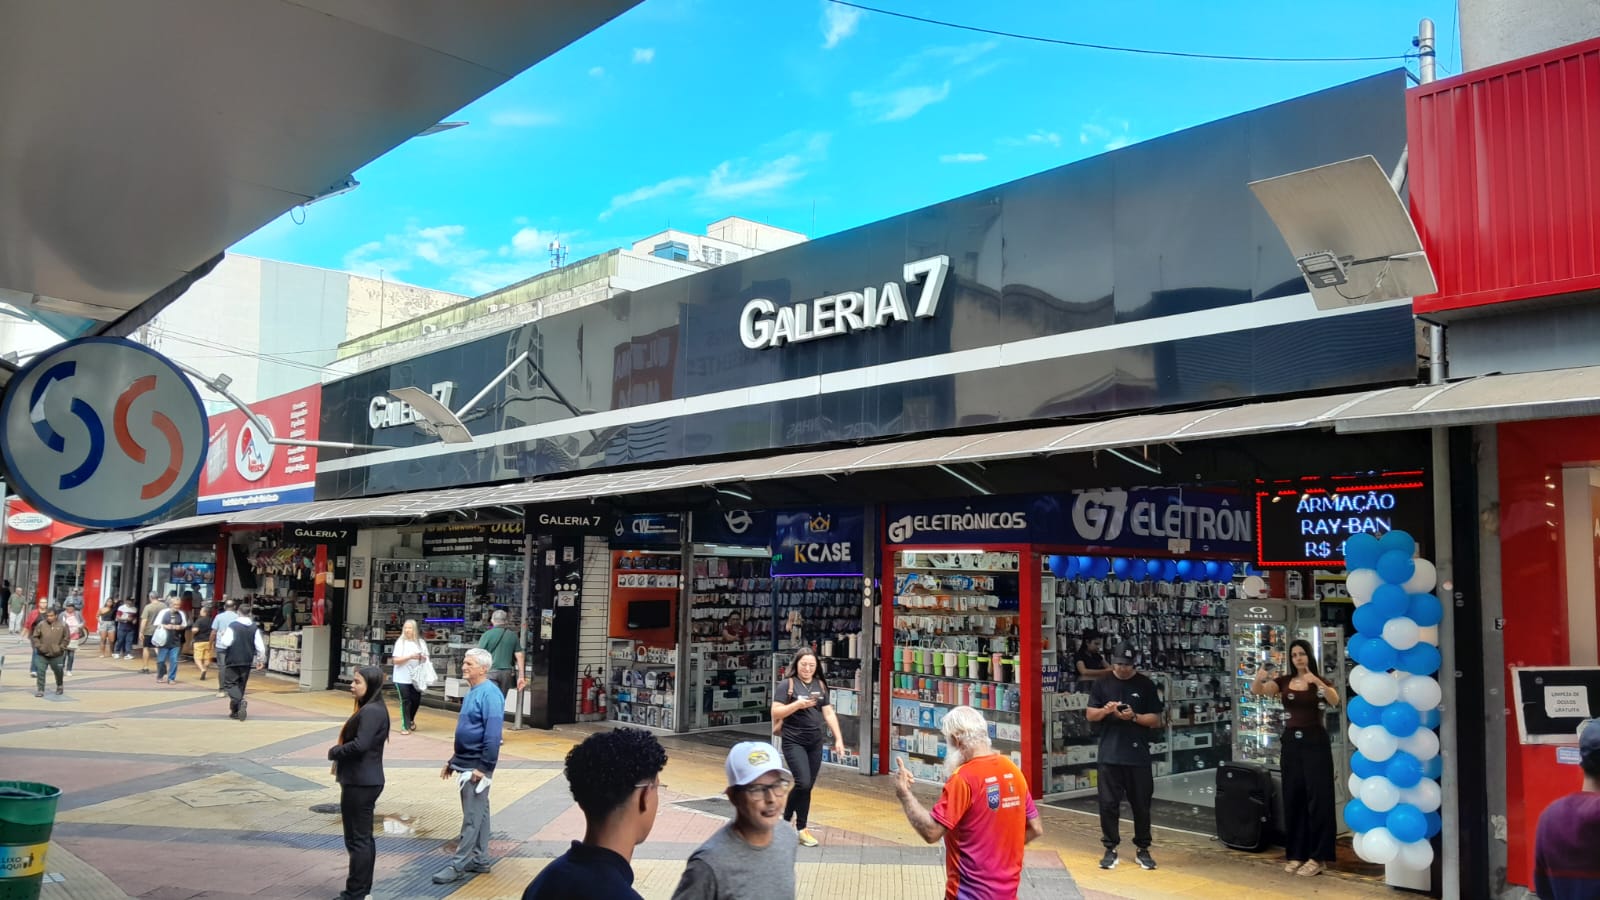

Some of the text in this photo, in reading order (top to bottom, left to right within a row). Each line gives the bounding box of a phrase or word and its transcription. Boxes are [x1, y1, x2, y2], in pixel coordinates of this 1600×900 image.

[739, 254, 949, 350] GALERIA 7
[1297, 491, 1395, 513] ARMAÇÃO
[540, 514, 601, 526] GALERIA 7
[888, 506, 1027, 543] G7 ELETRÔNICOS
[1072, 488, 1252, 542] G7 ELETRÔN
[294, 528, 348, 538] GALERIA 7
[1301, 517, 1391, 536] RAY-BAN
[1305, 541, 1331, 558] R$
